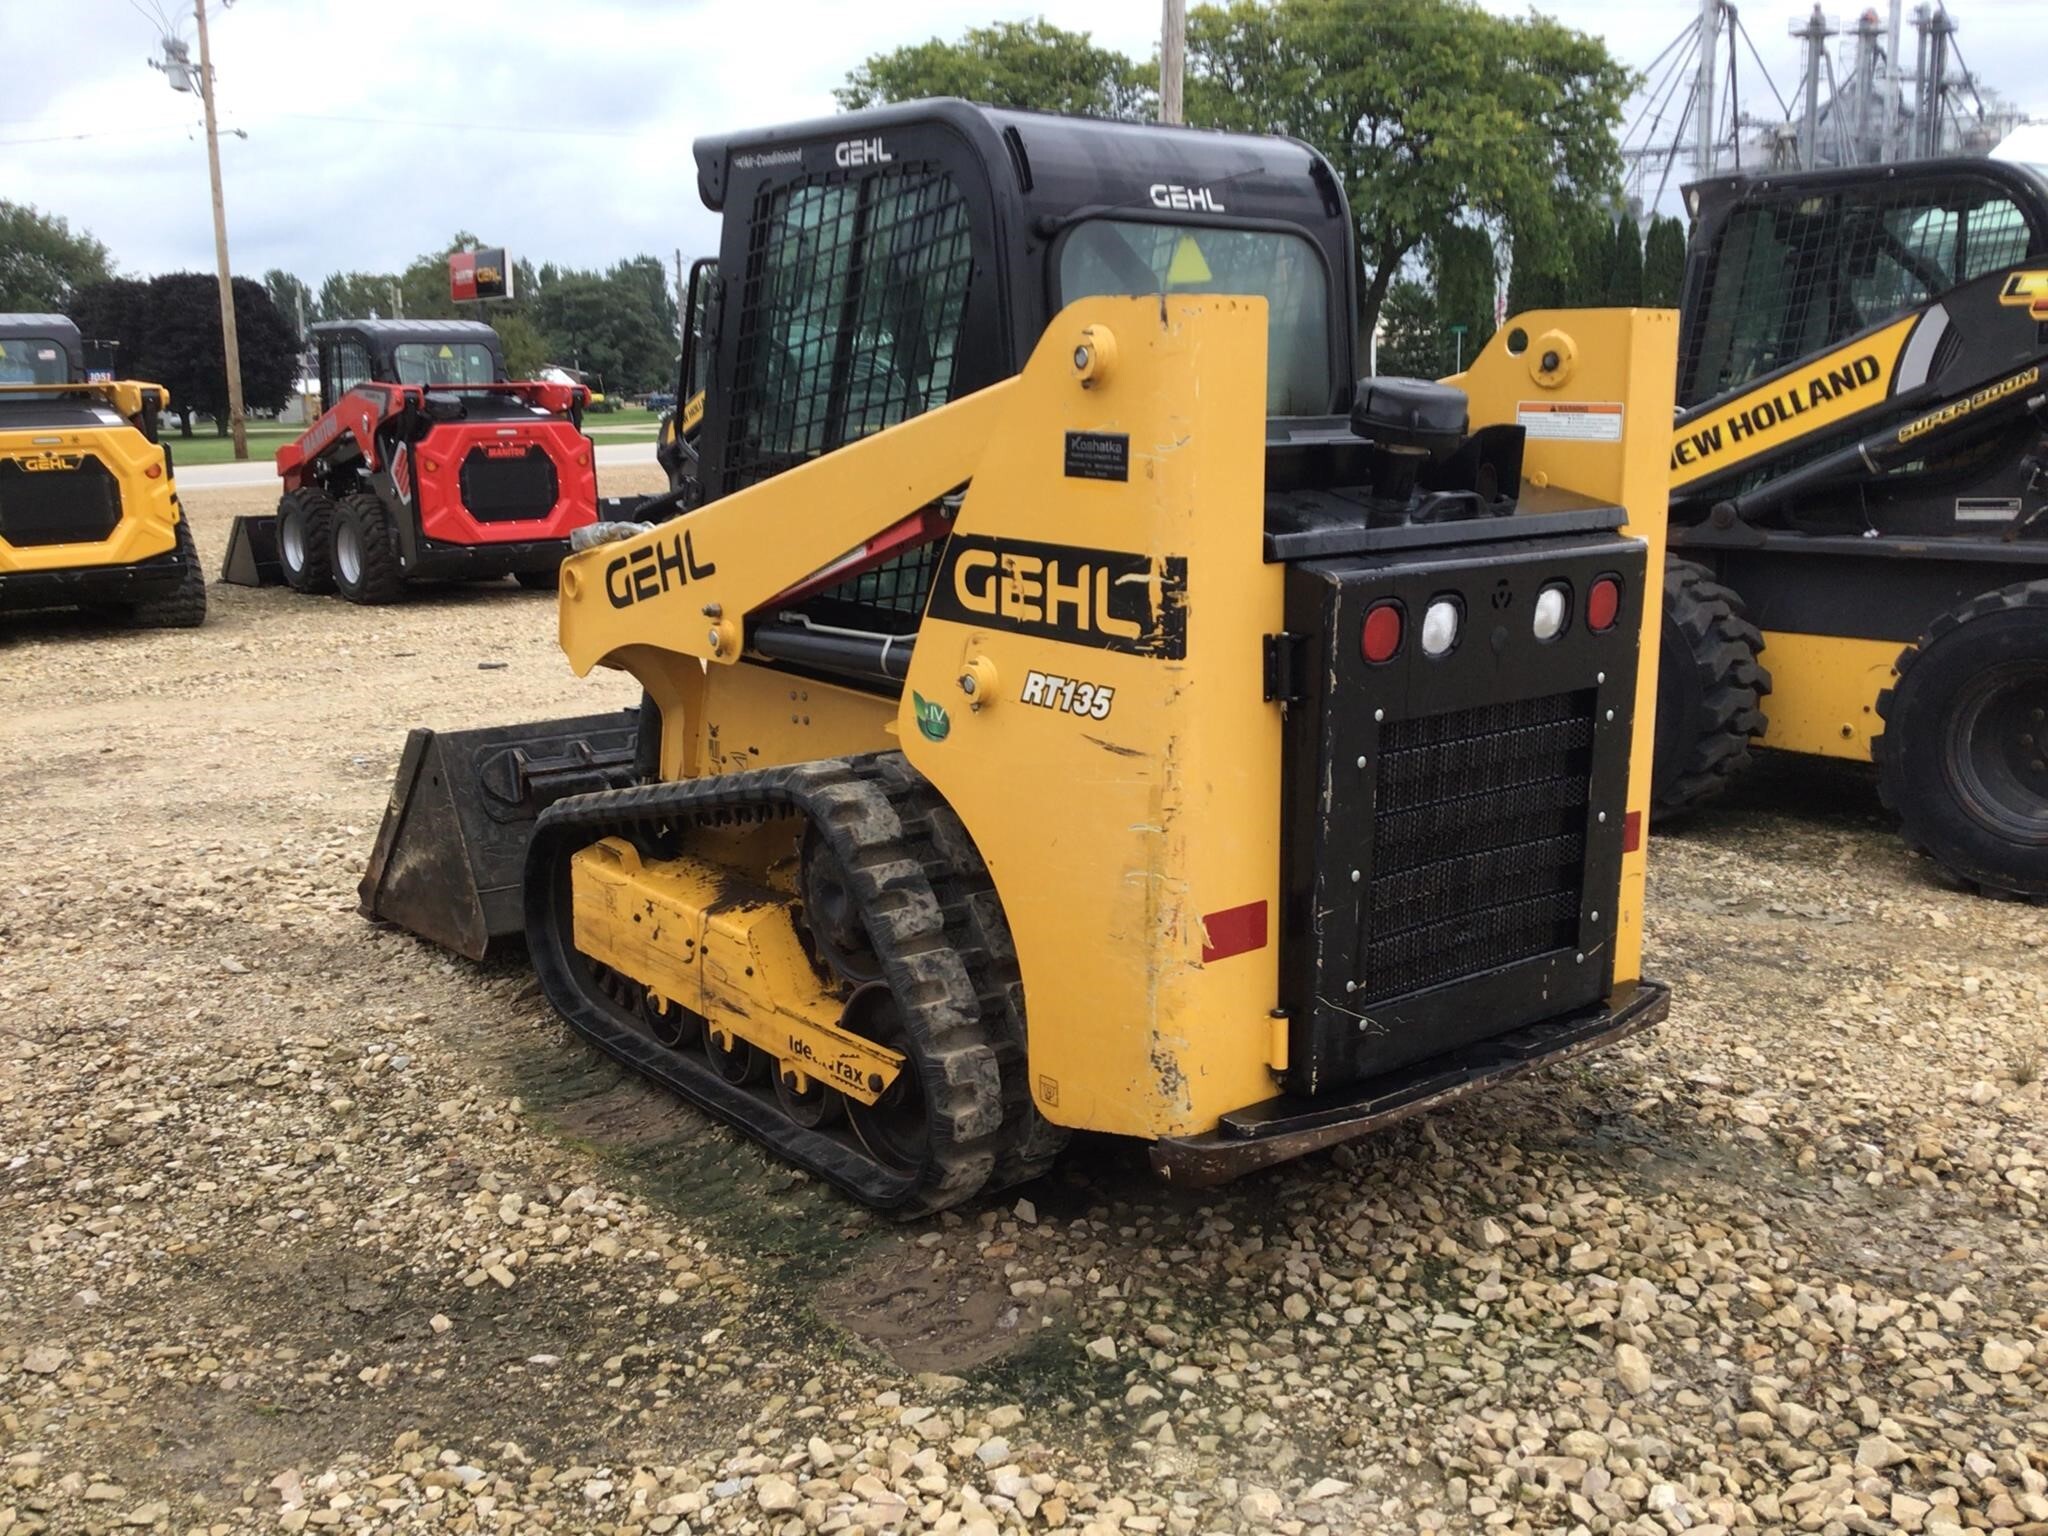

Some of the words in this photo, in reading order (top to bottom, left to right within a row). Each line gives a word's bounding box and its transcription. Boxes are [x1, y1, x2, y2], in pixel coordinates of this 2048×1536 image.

[835, 137, 892, 167] GEHL
[1150, 183, 1225, 213] GEHL
[1726, 354, 1881, 444] HOLLAND
[1899, 399, 1971, 443] SUPER
[1972, 366, 2039, 410] BOOM
[25, 458, 75, 470] GEHL
[605, 528, 716, 610] GEHL
[954, 548, 1143, 641] GEHL
[1021, 669, 1116, 721] RT135
